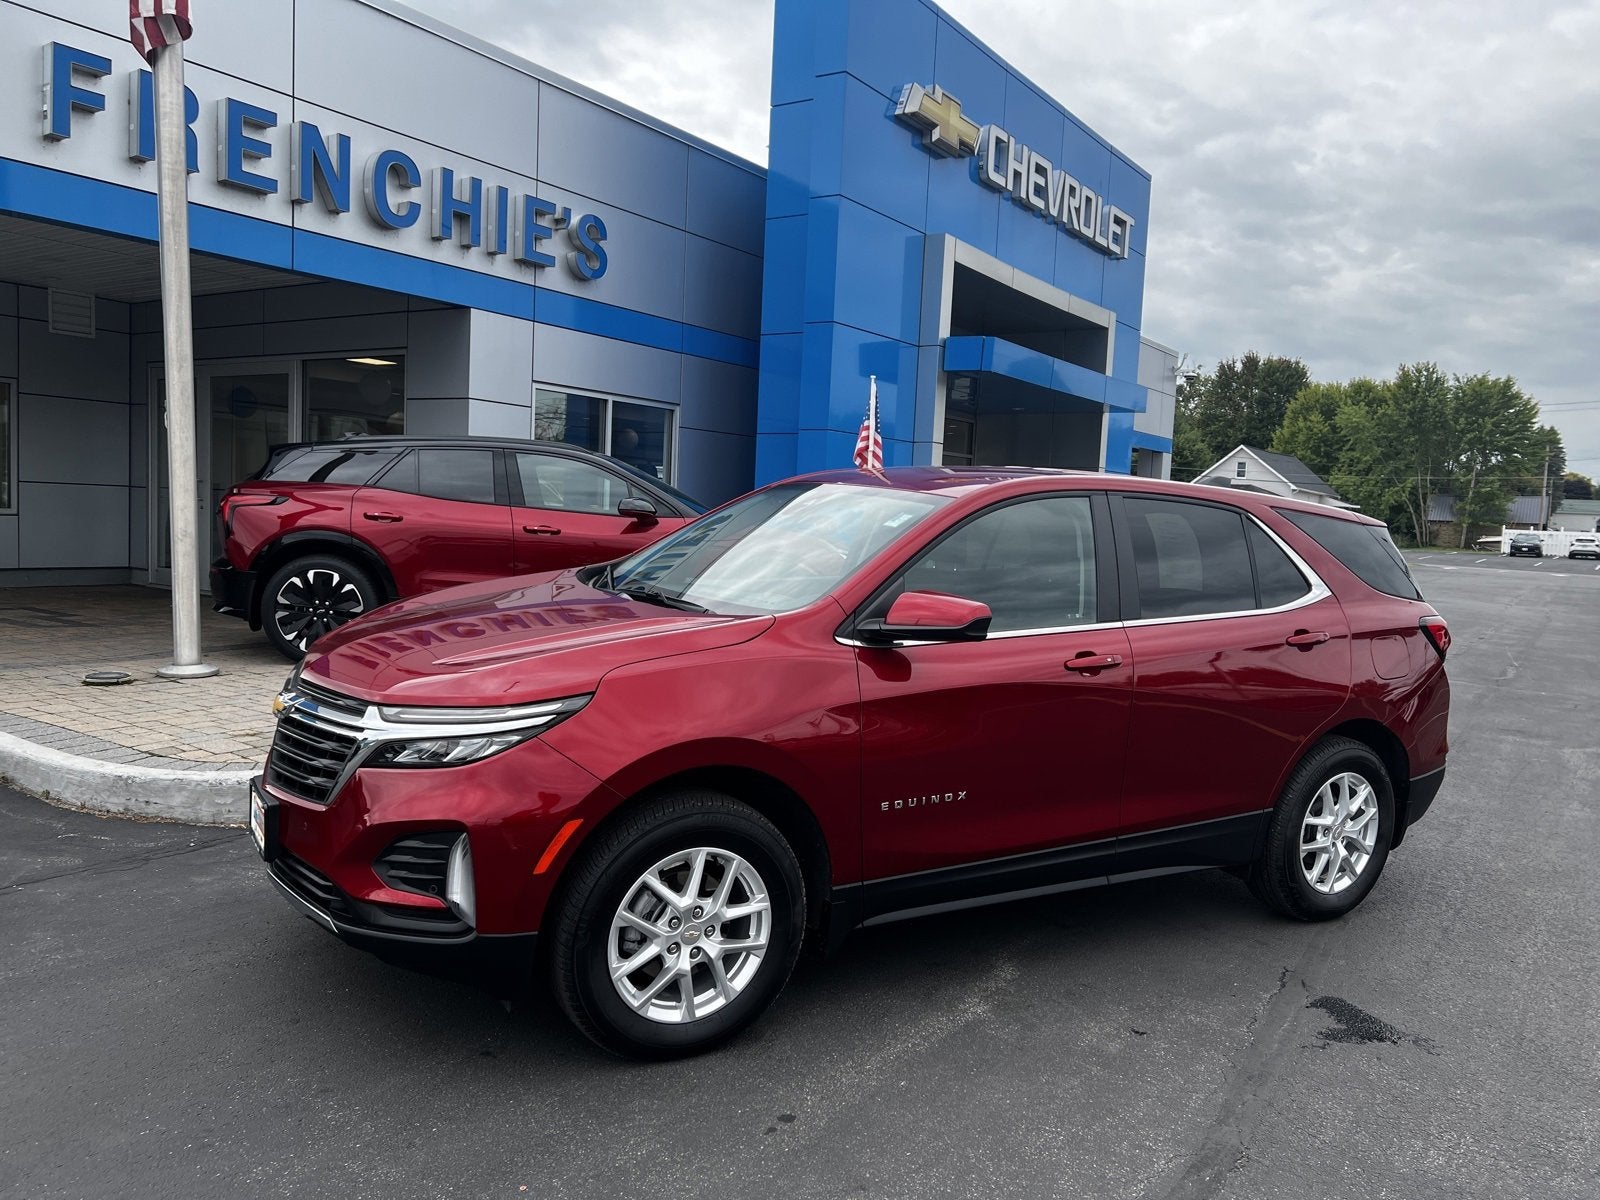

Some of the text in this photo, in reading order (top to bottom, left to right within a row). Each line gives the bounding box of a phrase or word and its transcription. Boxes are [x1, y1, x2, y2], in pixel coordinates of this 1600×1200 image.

[42, 41, 609, 281] FRENCHIE'S
[979, 124, 1135, 260] CHEVROLET
[881, 791, 967, 811] EQUINOX
